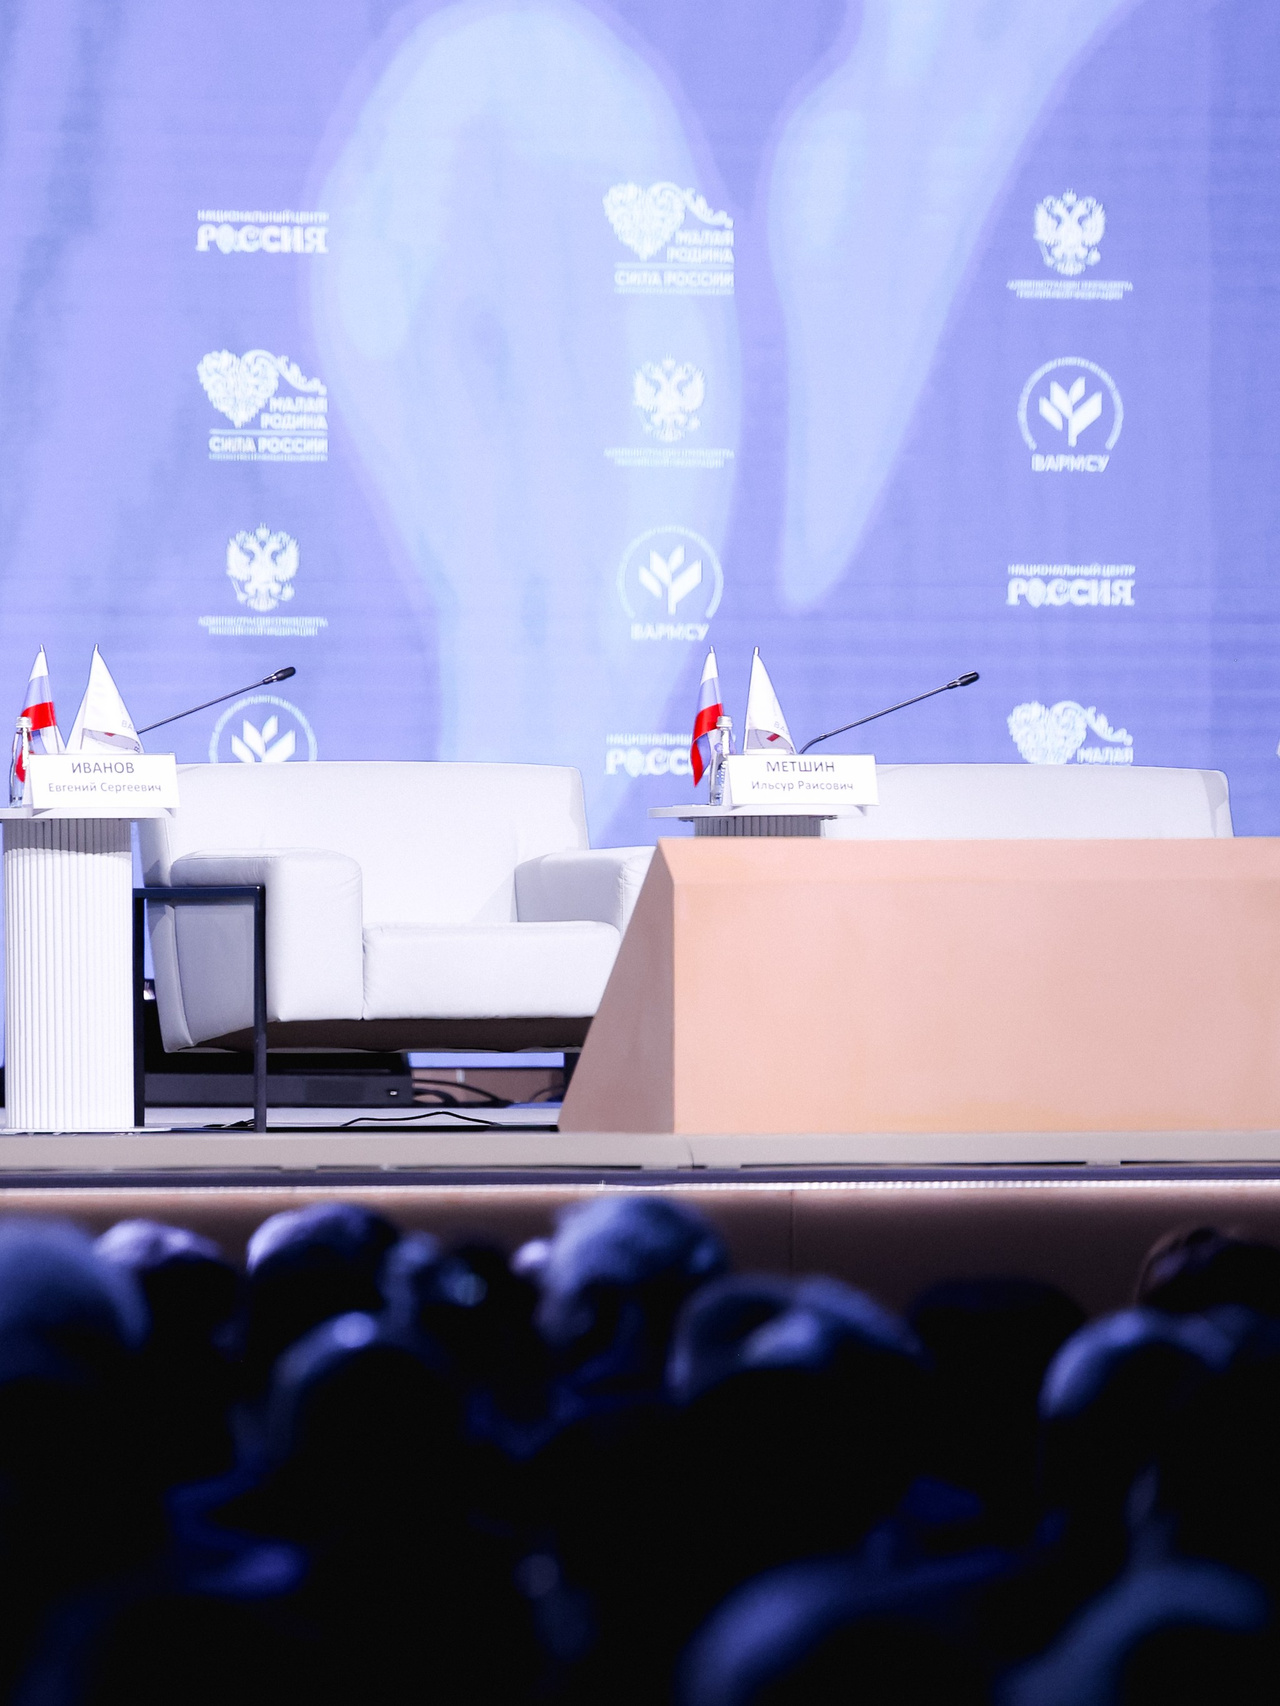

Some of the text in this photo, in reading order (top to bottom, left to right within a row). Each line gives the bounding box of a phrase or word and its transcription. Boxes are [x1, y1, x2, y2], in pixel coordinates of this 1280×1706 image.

[196, 223, 329, 254] РОССИЯ
[1005, 578, 1136, 608] РОССИЯ
[71, 762, 135, 774] ИВАНОВ
[604, 748, 692, 777] РОСС
[766, 761, 835, 772] МЕТШИН
[48, 782, 162, 794] Евгений Сергеевич
[751, 780, 854, 791] Ильсур Раисович
